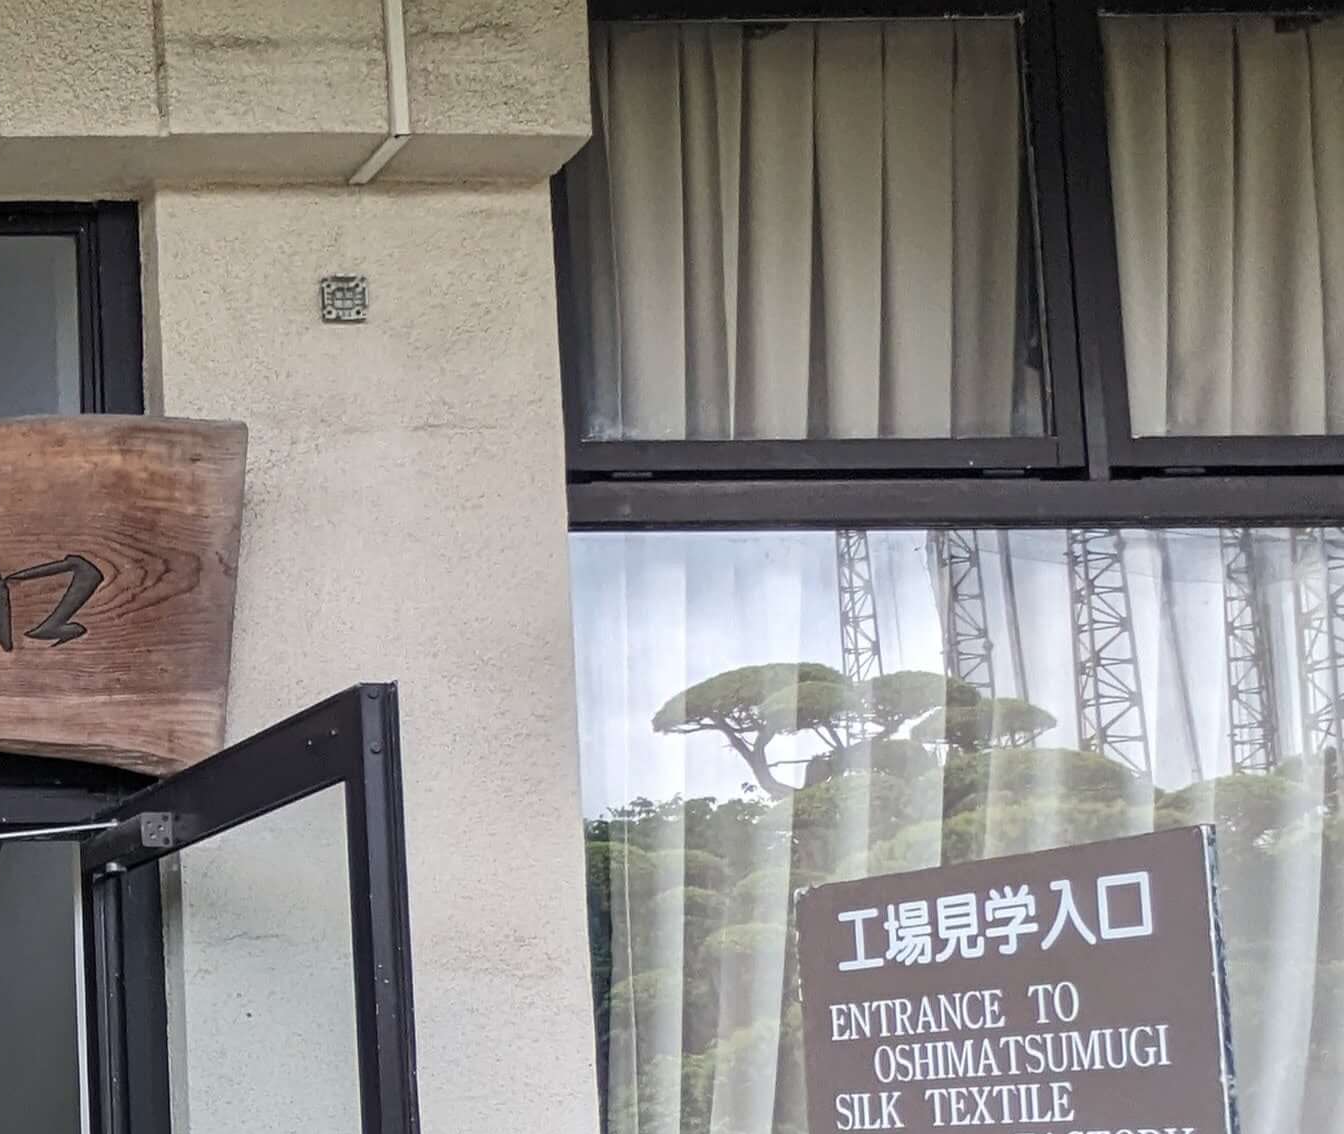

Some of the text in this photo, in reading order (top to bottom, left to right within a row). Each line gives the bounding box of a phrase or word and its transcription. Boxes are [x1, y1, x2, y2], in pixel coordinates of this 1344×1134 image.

[837, 871, 1153, 971] 工場見学入口
[830, 981, 1079, 1041] ENTRANCE TO
[874, 1025, 1171, 1083] OSHIMATSUMUGI
[835, 1082, 1075, 1131] SILK TEXTILE
